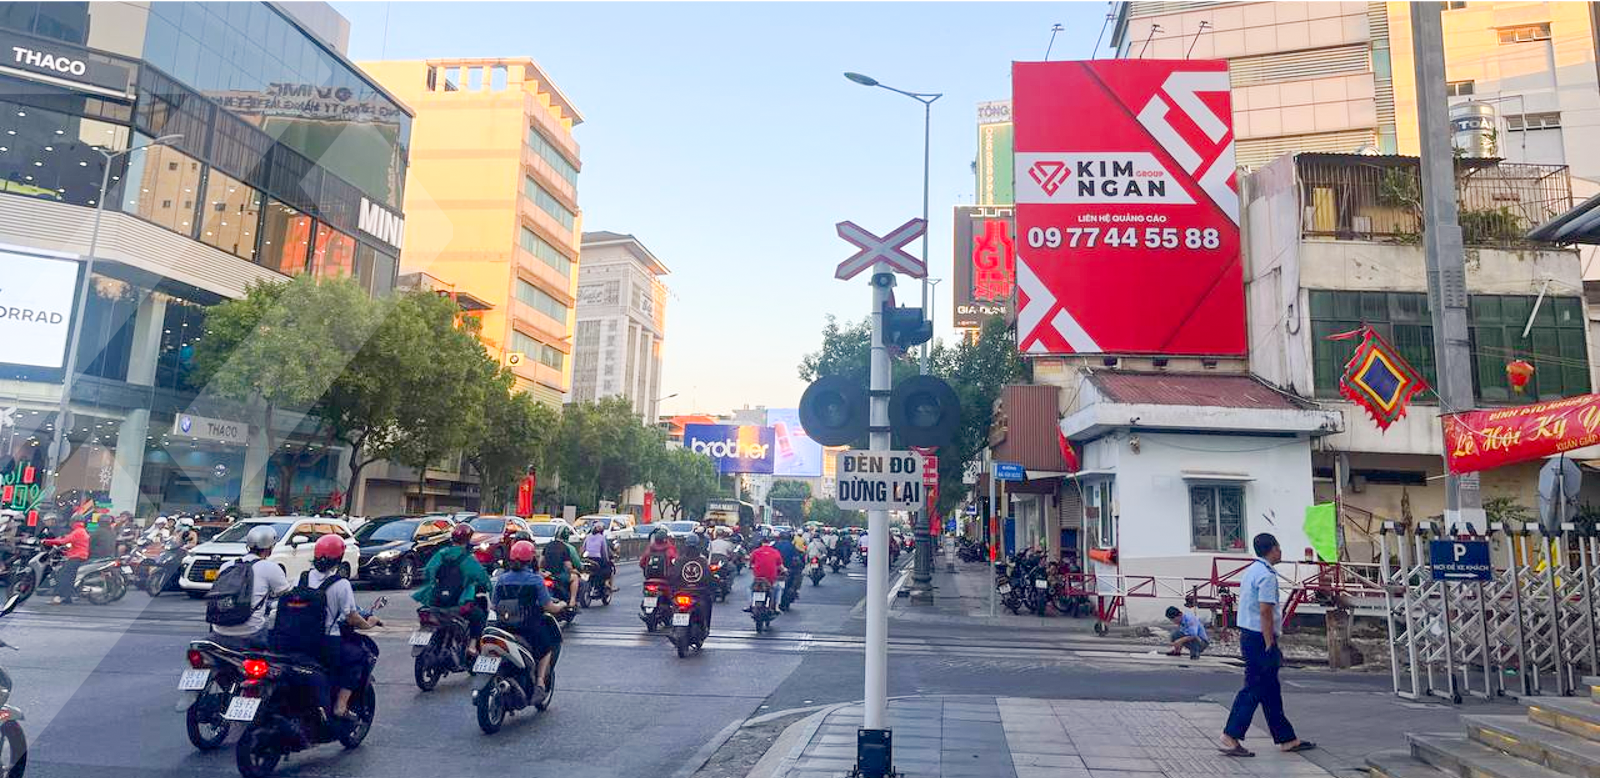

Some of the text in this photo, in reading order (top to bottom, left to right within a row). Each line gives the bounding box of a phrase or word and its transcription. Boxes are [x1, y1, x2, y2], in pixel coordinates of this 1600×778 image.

[12, 46, 86, 77] THACO
[1077, 160, 1134, 178] KIM
[1077, 179, 1166, 197] NGAN
[358, 196, 404, 249] MINI
[1078, 213, 1097, 223] LIÊN
[1112, 213, 1144, 223] QUẢNG
[1027, 227, 1061, 249] 09
[1066, 227, 1101, 249] 77
[1103, 227, 1138, 249] 44
[1144, 227, 1179, 249] 55
[1184, 227, 1220, 249] 88
[208, 420, 238, 438] THACO
[691, 436, 770, 459] brother
[843, 452, 883, 474] ĐÈN
[889, 451, 916, 474] ĐỎ
[838, 475, 920, 507] DỪNG LẠI
[1453, 543, 1467, 562] P
